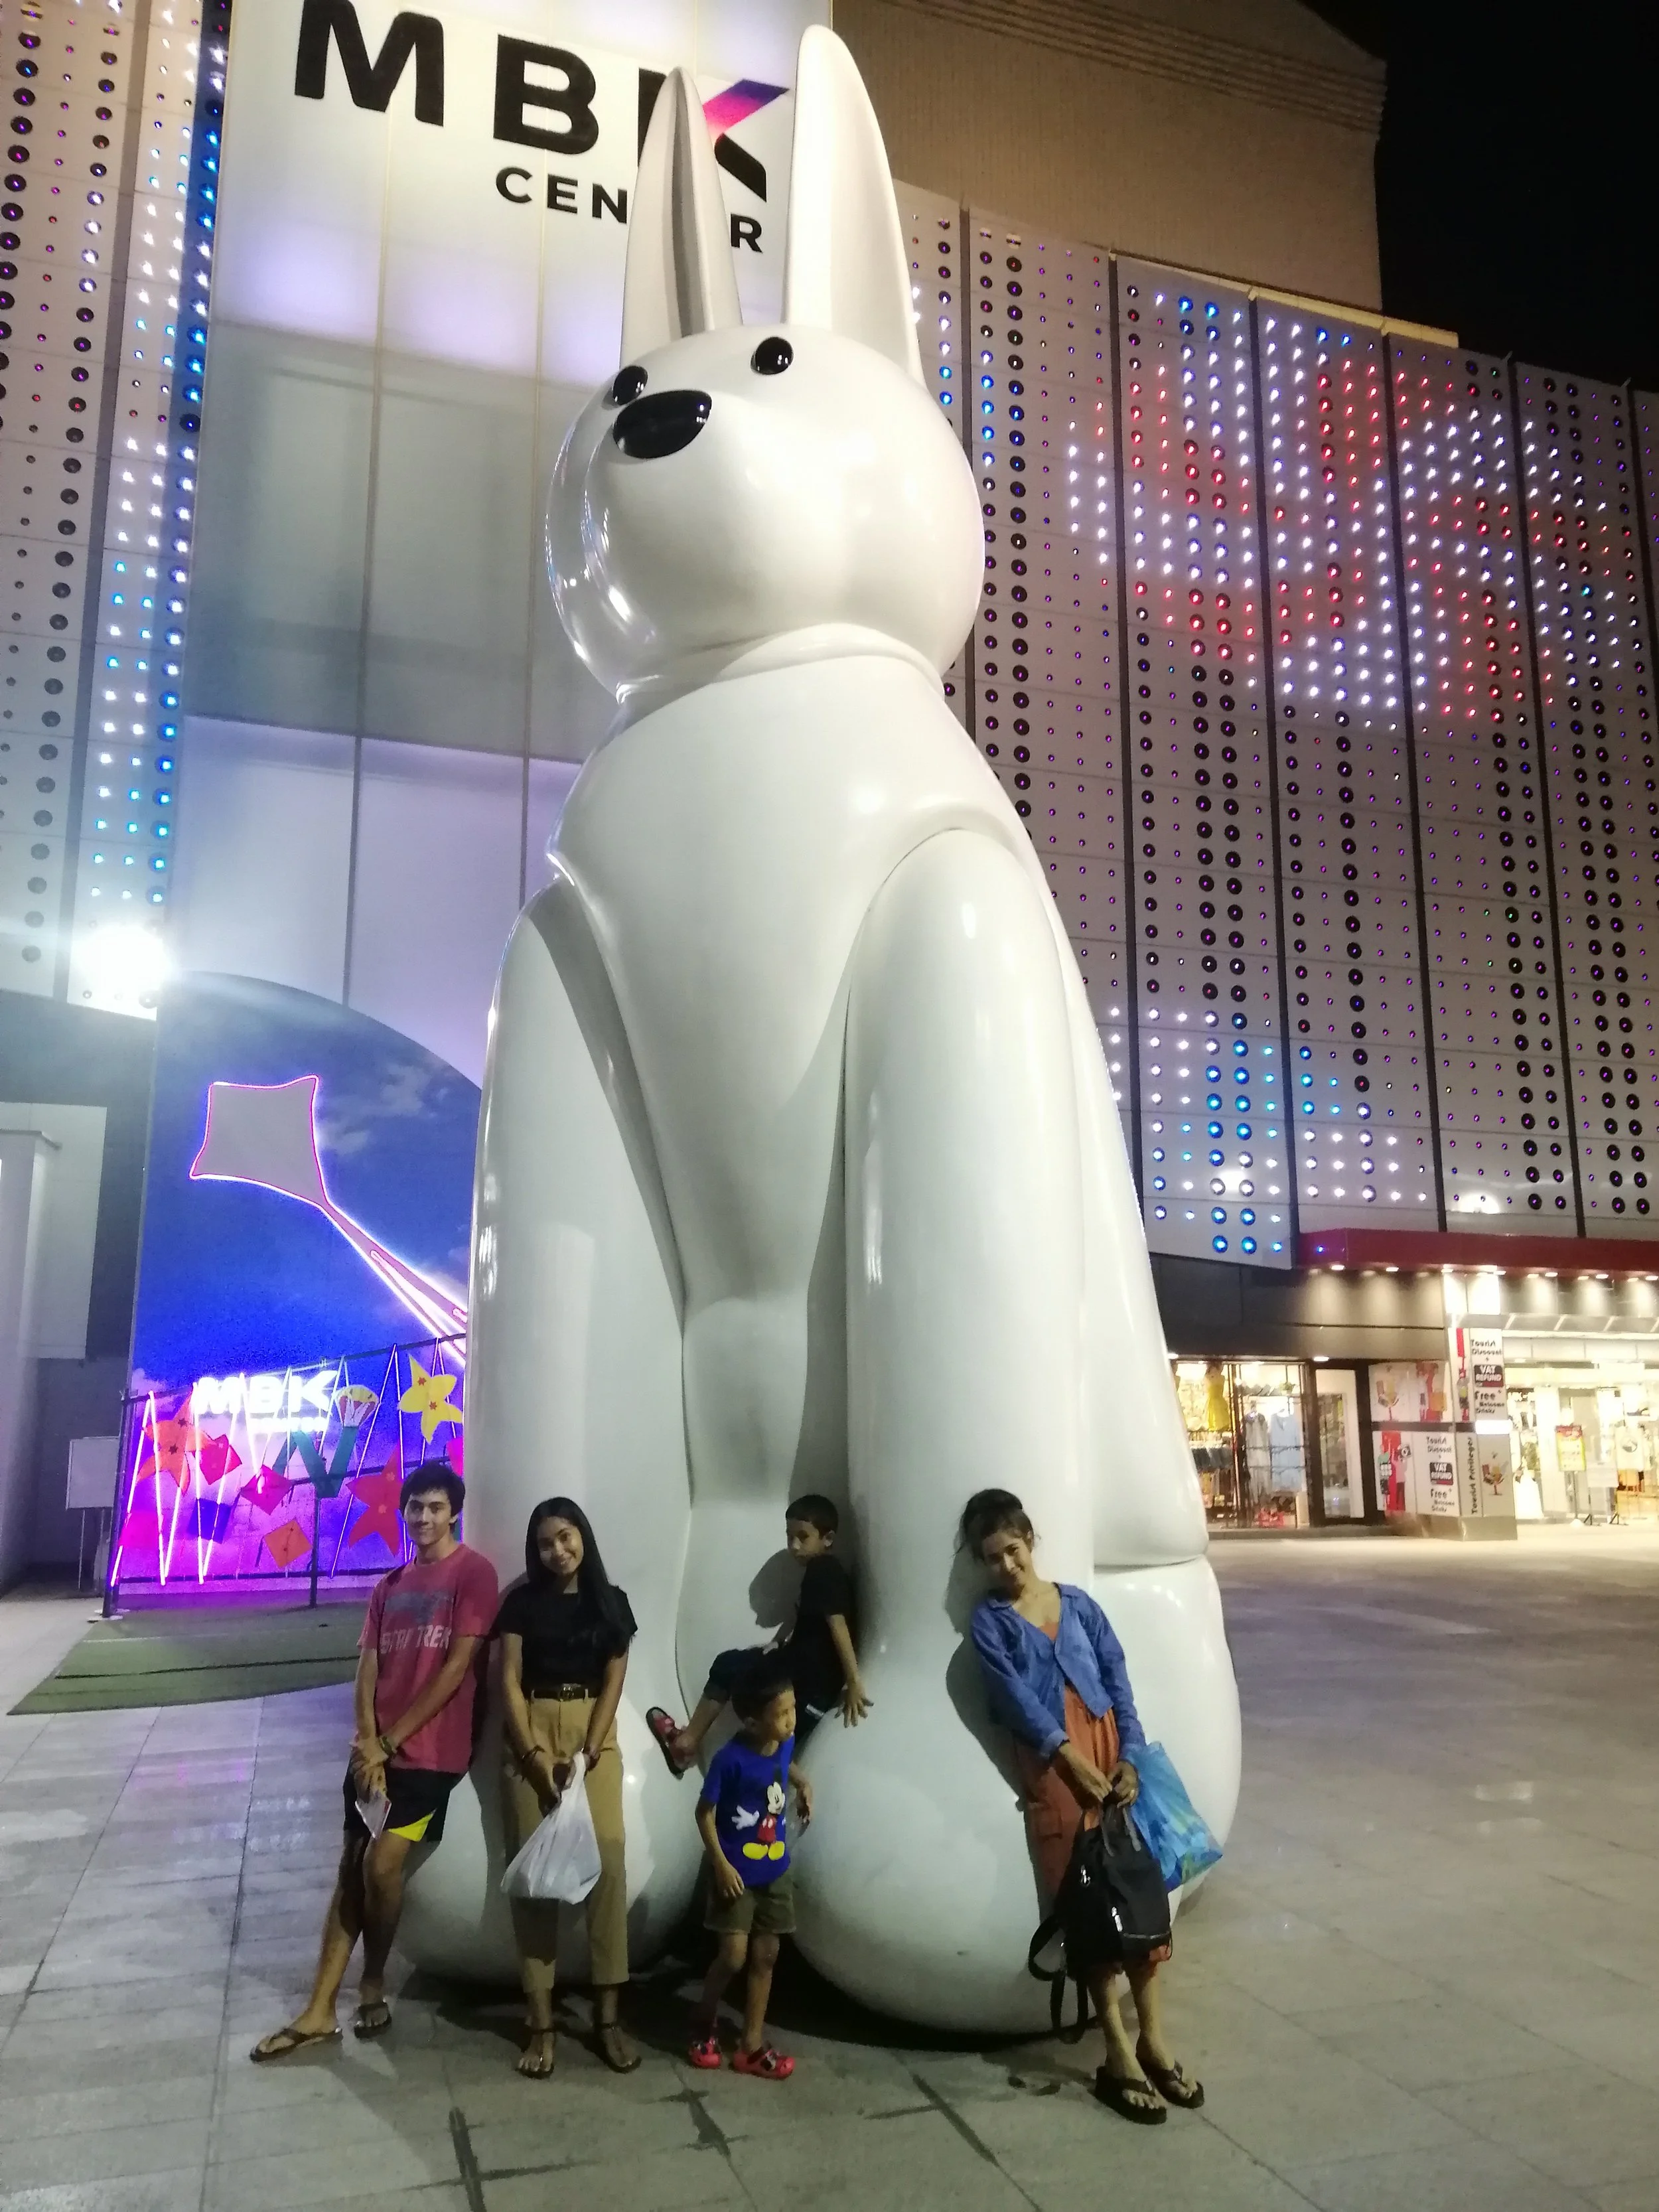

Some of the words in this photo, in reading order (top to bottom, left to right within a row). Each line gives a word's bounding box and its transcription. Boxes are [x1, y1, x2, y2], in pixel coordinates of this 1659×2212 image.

[295, 0, 789, 203] MBK
[496, 166, 763, 254] CENR
[197, 1370, 338, 1414] MBK
[1475, 1391, 1496, 1400] Free
[1434, 1463, 1447, 1472] VAT
[1431, 1489, 1447, 1499] Free
